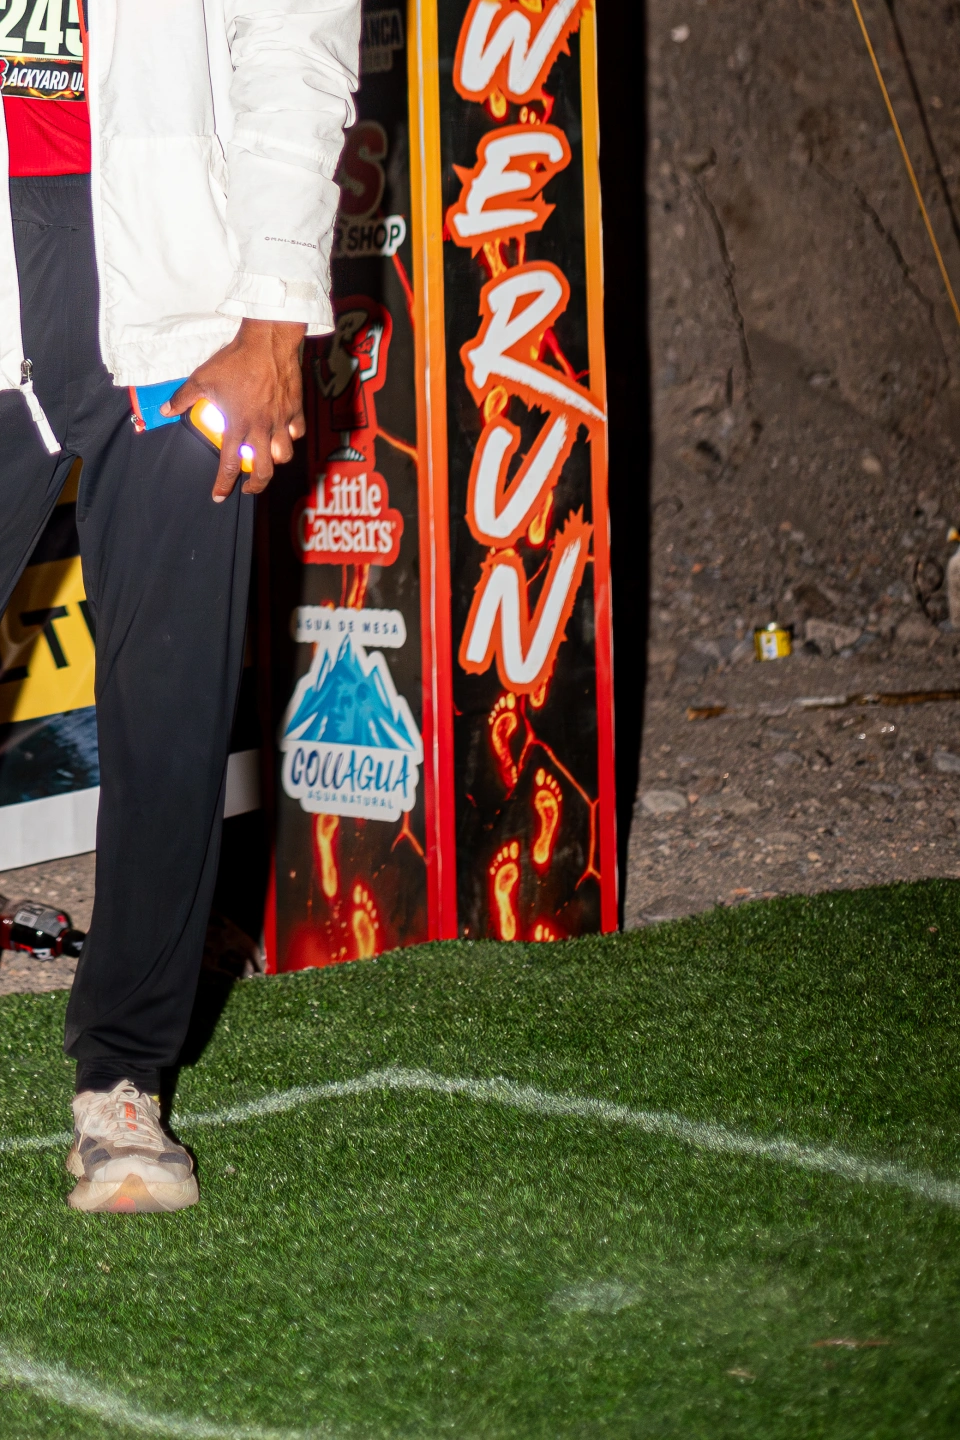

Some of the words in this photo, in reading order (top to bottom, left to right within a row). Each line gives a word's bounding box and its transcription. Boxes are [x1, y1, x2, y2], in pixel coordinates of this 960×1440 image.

[347, 224, 401, 251] SHOP
[315, 472, 383, 518] Little
[297, 506, 394, 554] Caesars
[338, 619, 355, 633] DE
[362, 621, 399, 635] MESA
[340, 794, 394, 810] NATURAL
